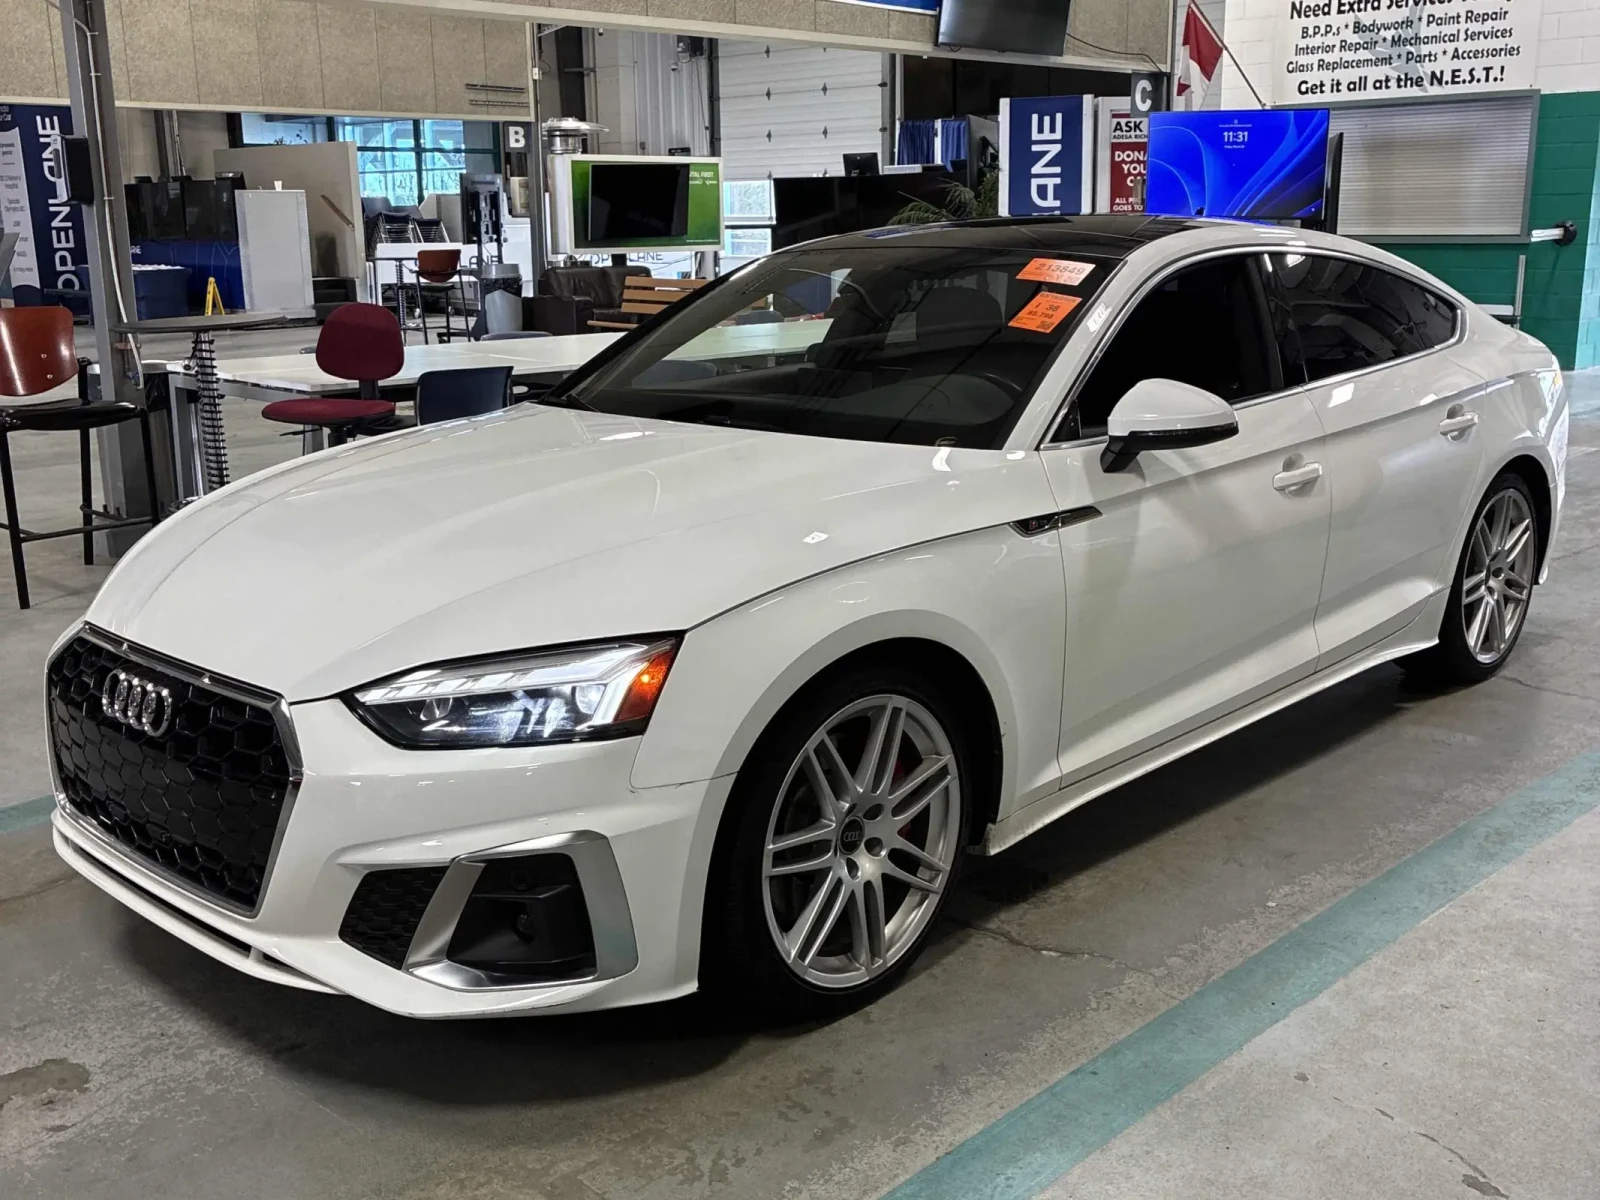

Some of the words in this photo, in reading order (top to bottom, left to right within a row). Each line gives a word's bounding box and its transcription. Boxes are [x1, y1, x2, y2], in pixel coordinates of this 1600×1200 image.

[1290, 0, 1332, 19] Need
[1337, 0, 1381, 15] Extra
[1386, 0, 1453, 10] Serv
[1301, 24, 1341, 39] B.P.P.s
[1353, 16, 1414, 35] Bodywork
[1427, 12, 1461, 27] Paint
[1465, 7, 1509, 25] Repair
[1295, 41, 1336, 56] Interior
[1339, 37, 1379, 54] Repair
[1391, 29, 1460, 48] Mechanical
[1463, 26, 1513, 42] Services
[1286, 60, 1314, 74] Glass
[1317, 53, 1393, 73] Replacement
[1405, 50, 1438, 64] Parts
[1450, 43, 1521, 61] Accessories
[1297, 79, 1326, 95] Get
[1330, 78, 1342, 93] it
[1346, 75, 1368, 92] all
[1372, 75, 1391, 90] at
[1396, 72, 1424, 89] the
[1429, 65, 1505, 87] N.E.S.T.!
[1135, 79, 1152, 112] C
[508, 126, 526, 148] B
[1113, 120, 1144, 133] ASK
[1223, 131, 1249, 142] 11:31
[1031, 112, 1063, 216] ANE
[36, 115, 80, 291] OPENNE
[1113, 204, 1132, 212] GOES
[590, 252, 664, 265] OPLANE
[1035, 263, 1087, 276] 213849
